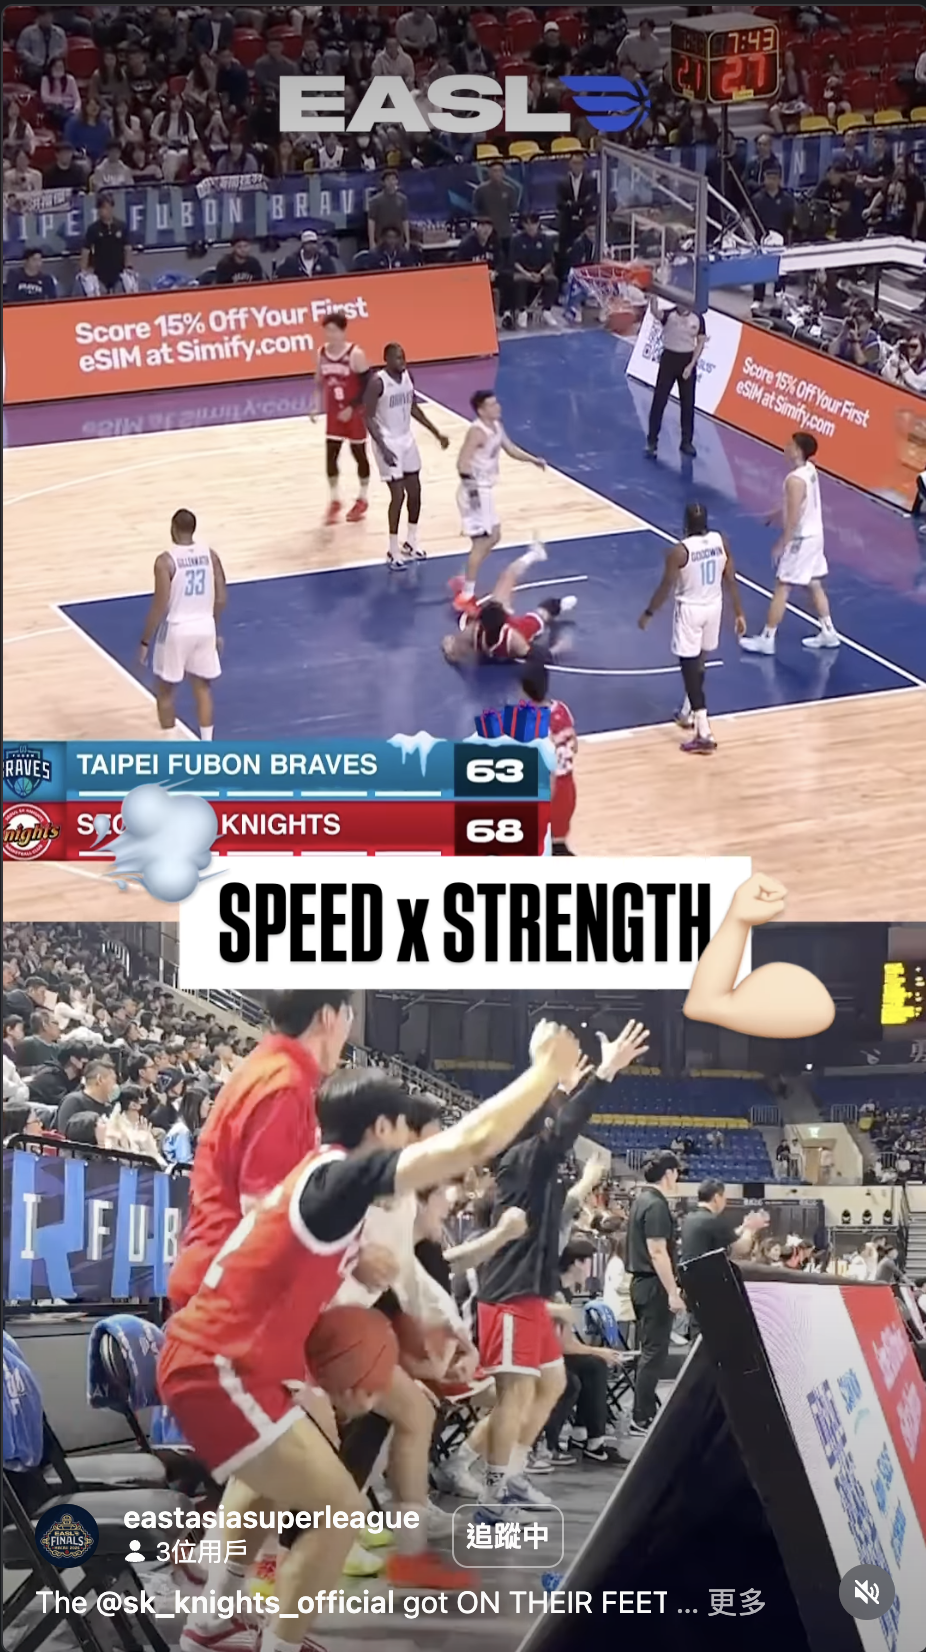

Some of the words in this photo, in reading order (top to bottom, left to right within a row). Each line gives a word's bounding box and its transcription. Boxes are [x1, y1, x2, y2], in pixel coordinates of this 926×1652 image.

[728, 28, 775, 53] 7:43
[722, 53, 766, 94] 27
[130, 197, 242, 232] FUBON
[76, 321, 151, 346] Score
[154, 312, 206, 337] 15%
[209, 306, 249, 332] Off
[250, 305, 309, 329] Your
[311, 297, 368, 323] First
[79, 346, 141, 373] eSIM
[146, 343, 173, 365] at
[175, 330, 314, 362] Simify.com
[736, 380, 764, 402] eSIM
[761, 392, 777, 408] at
[774, 396, 836, 437] Simify.com
[743, 357, 775, 384] Score
[775, 371, 796, 394] 15%
[796, 379, 818, 401] Off
[815, 387, 845, 415] Your
[841, 402, 871, 428] First
[184, 568, 206, 596] 33
[701, 559, 716, 586] 10
